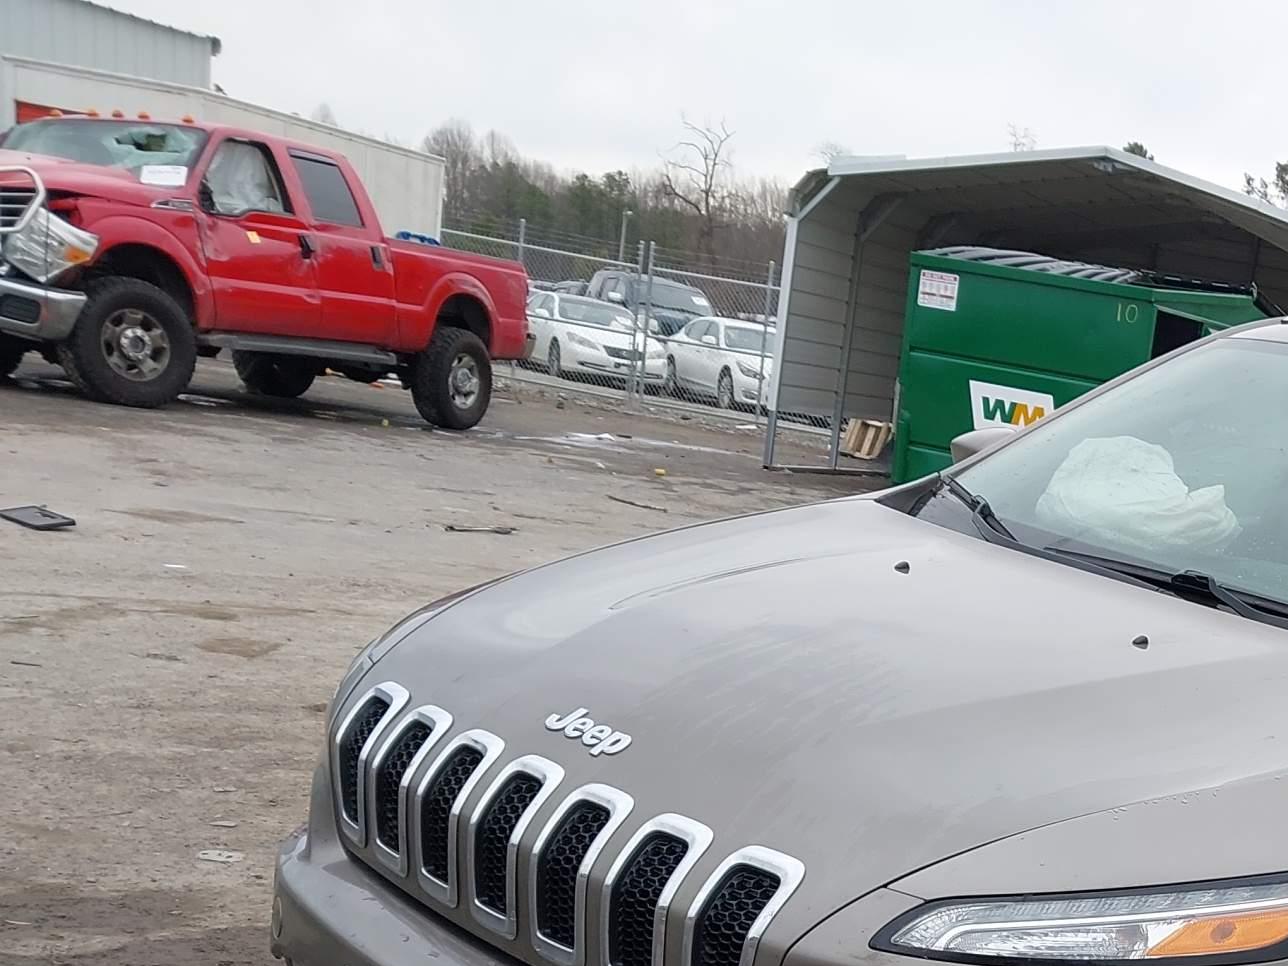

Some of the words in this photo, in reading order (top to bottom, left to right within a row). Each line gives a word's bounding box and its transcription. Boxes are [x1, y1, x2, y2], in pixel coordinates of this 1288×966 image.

[1116, 303, 1138, 323] 10
[982, 396, 1045, 426] WM
[544, 707, 632, 758] Jeep
